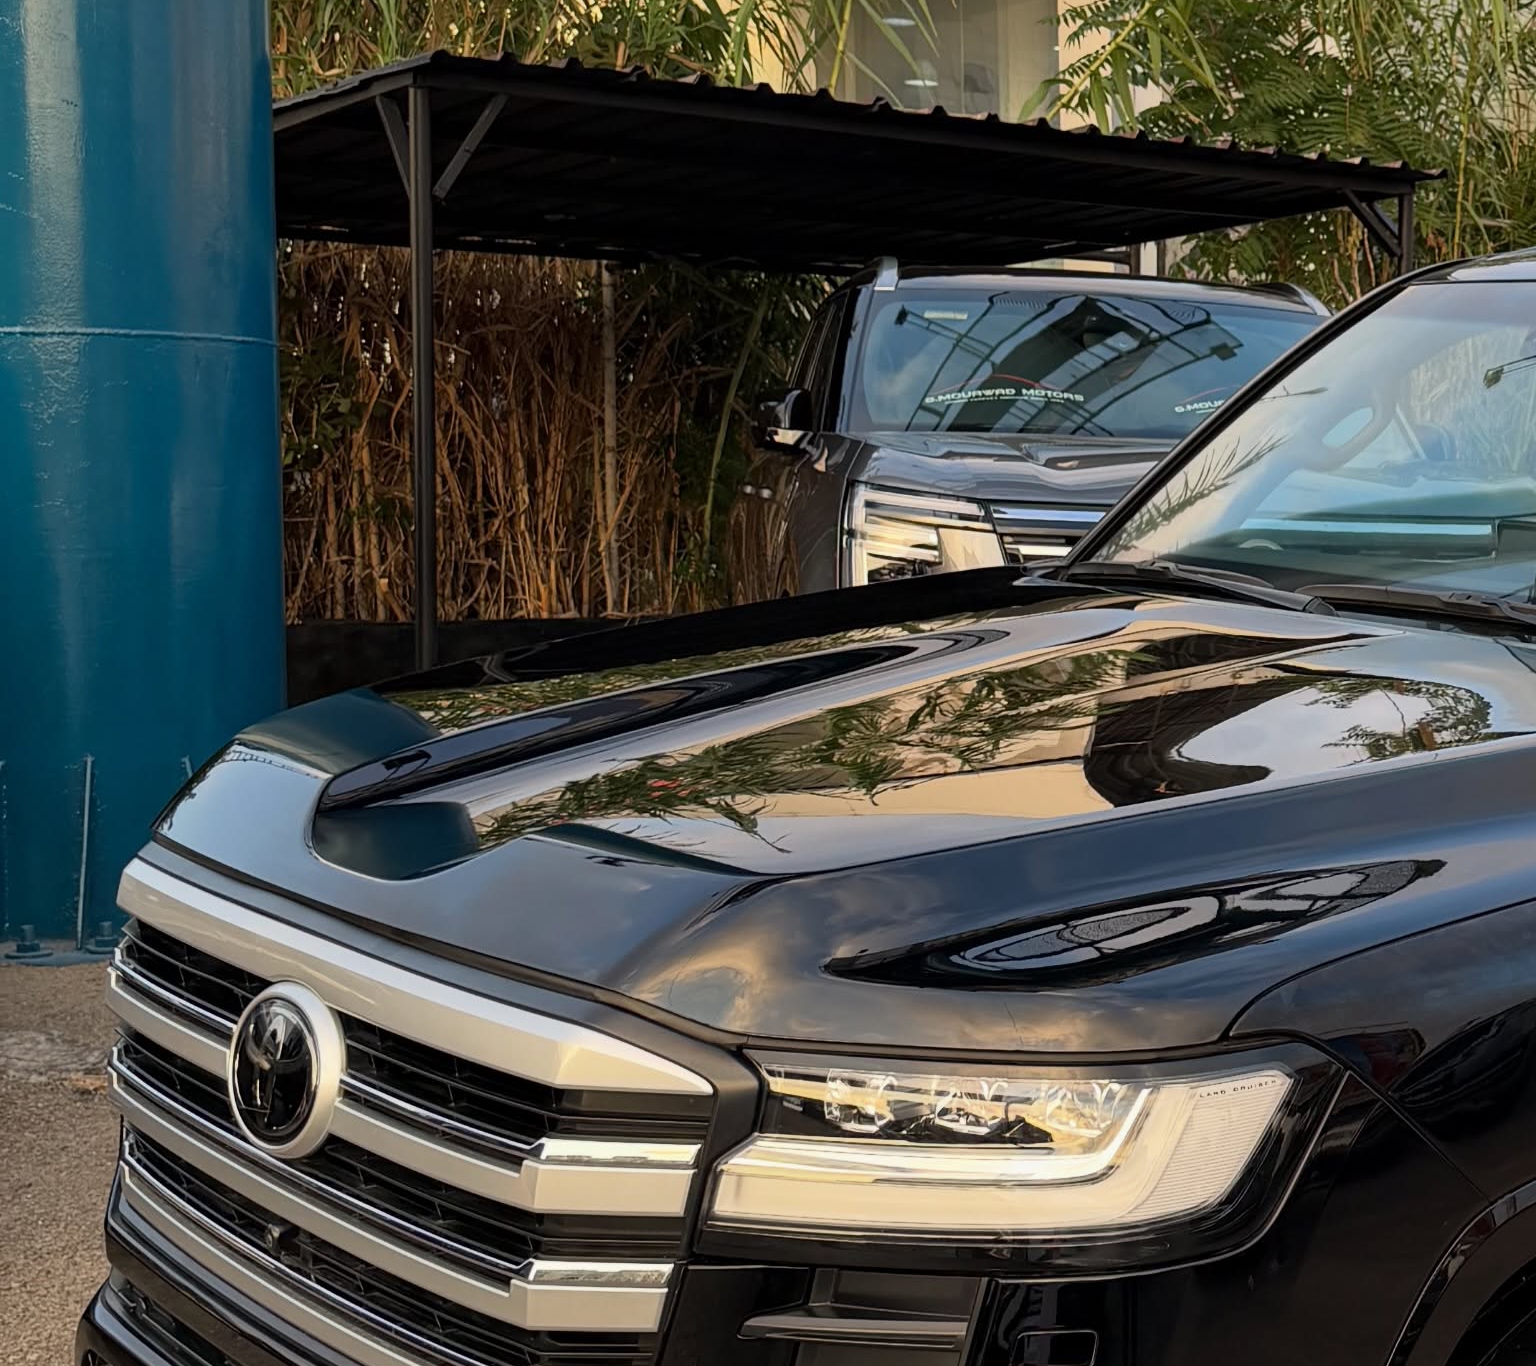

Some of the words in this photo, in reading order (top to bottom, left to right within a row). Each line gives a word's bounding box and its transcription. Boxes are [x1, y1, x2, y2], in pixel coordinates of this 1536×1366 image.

[1021, 388, 1085, 402] MOTORS
[1199, 1090, 1226, 1098] LAND
[1233, 1079, 1276, 1091] CRUISER
